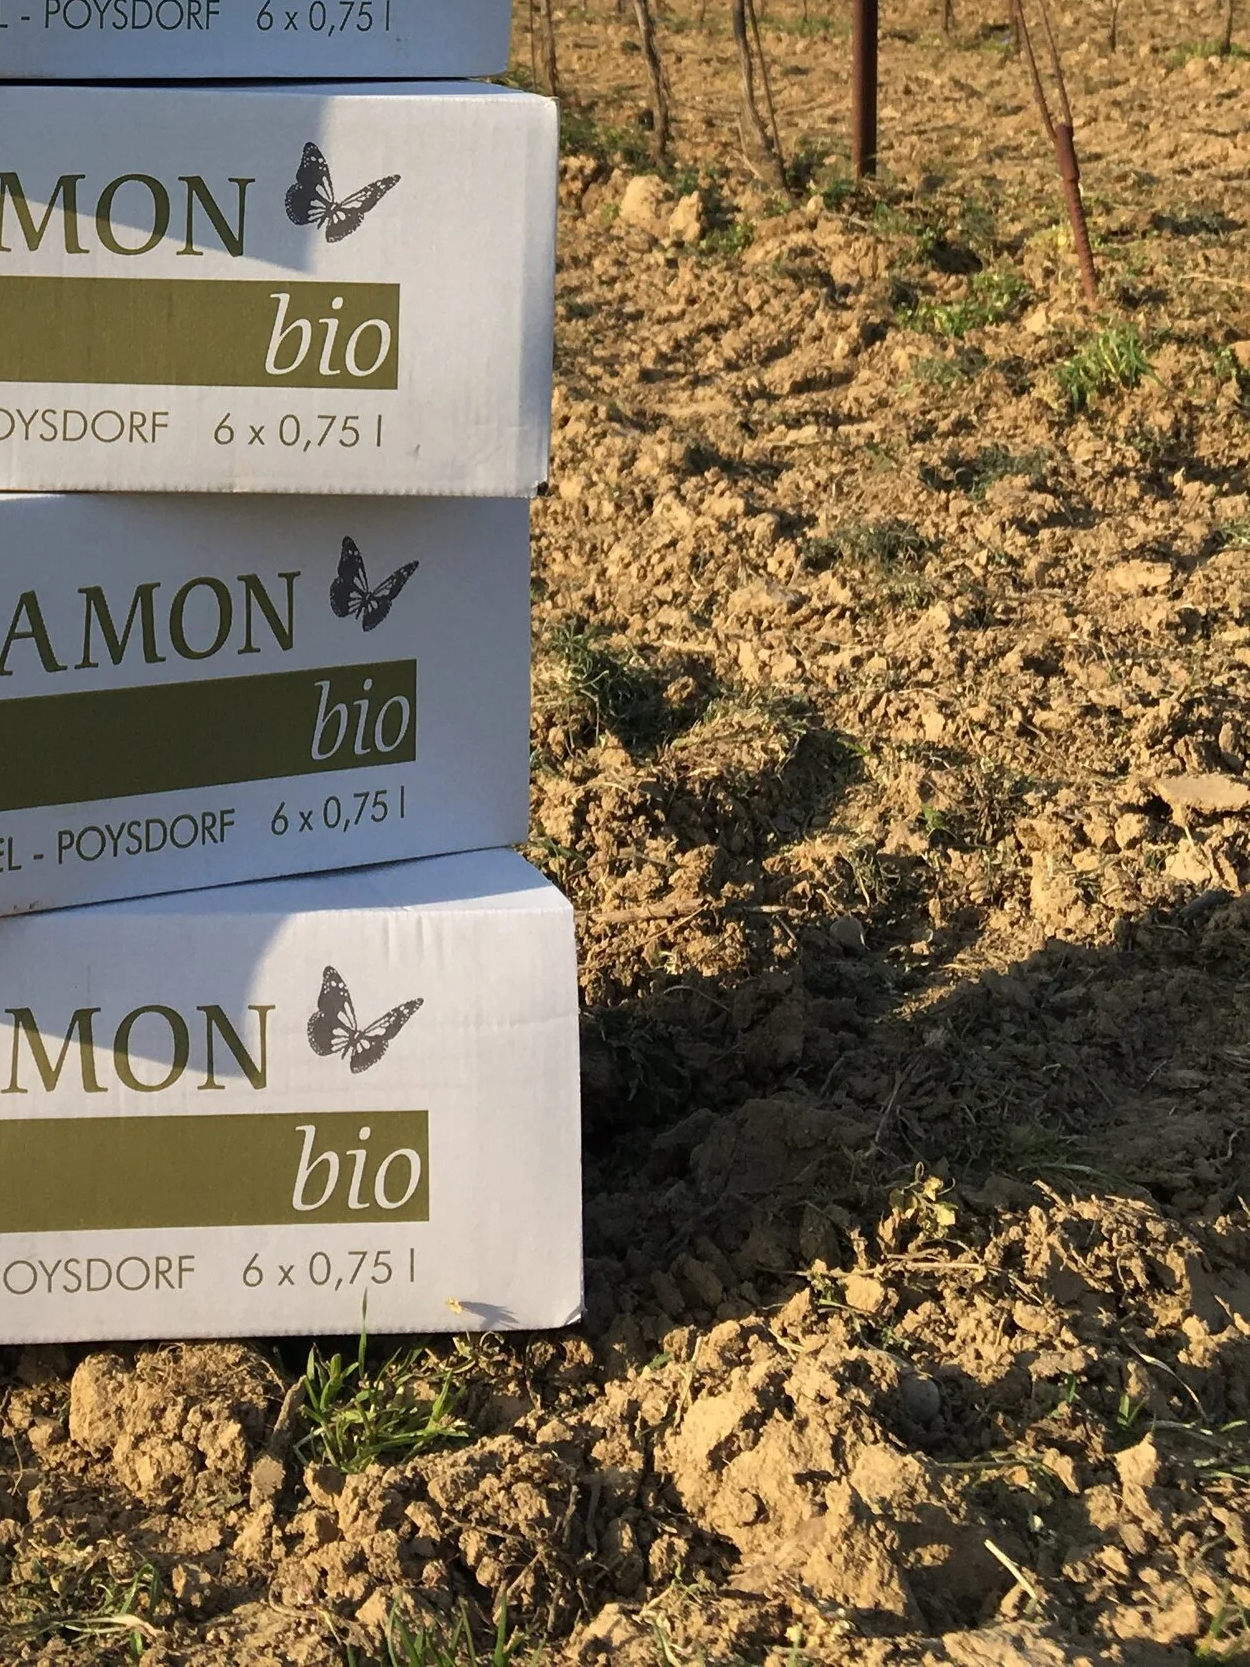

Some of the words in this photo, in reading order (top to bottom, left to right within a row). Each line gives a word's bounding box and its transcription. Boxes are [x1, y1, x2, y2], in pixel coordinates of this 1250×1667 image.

[256, 0, 274, 31] 6
[284, 10, 299, 31] x
[308, 0, 373, 38] 0,75
[265, 293, 391, 376] bio
[213, 413, 234, 445] 6
[248, 426, 265, 446] x
[279, 414, 361, 455] 0,75
[312, 679, 410, 761] bio
[57, 809, 235, 865] POYSDORF
[271, 801, 289, 835] 6
[299, 812, 313, 832] x
[322, 791, 389, 836] 0,75
[292, 1125, 421, 1212] bio
[242, 1252, 263, 1287] 6
[278, 1265, 295, 1287] x
[308, 1251, 393, 1291] 0,75
